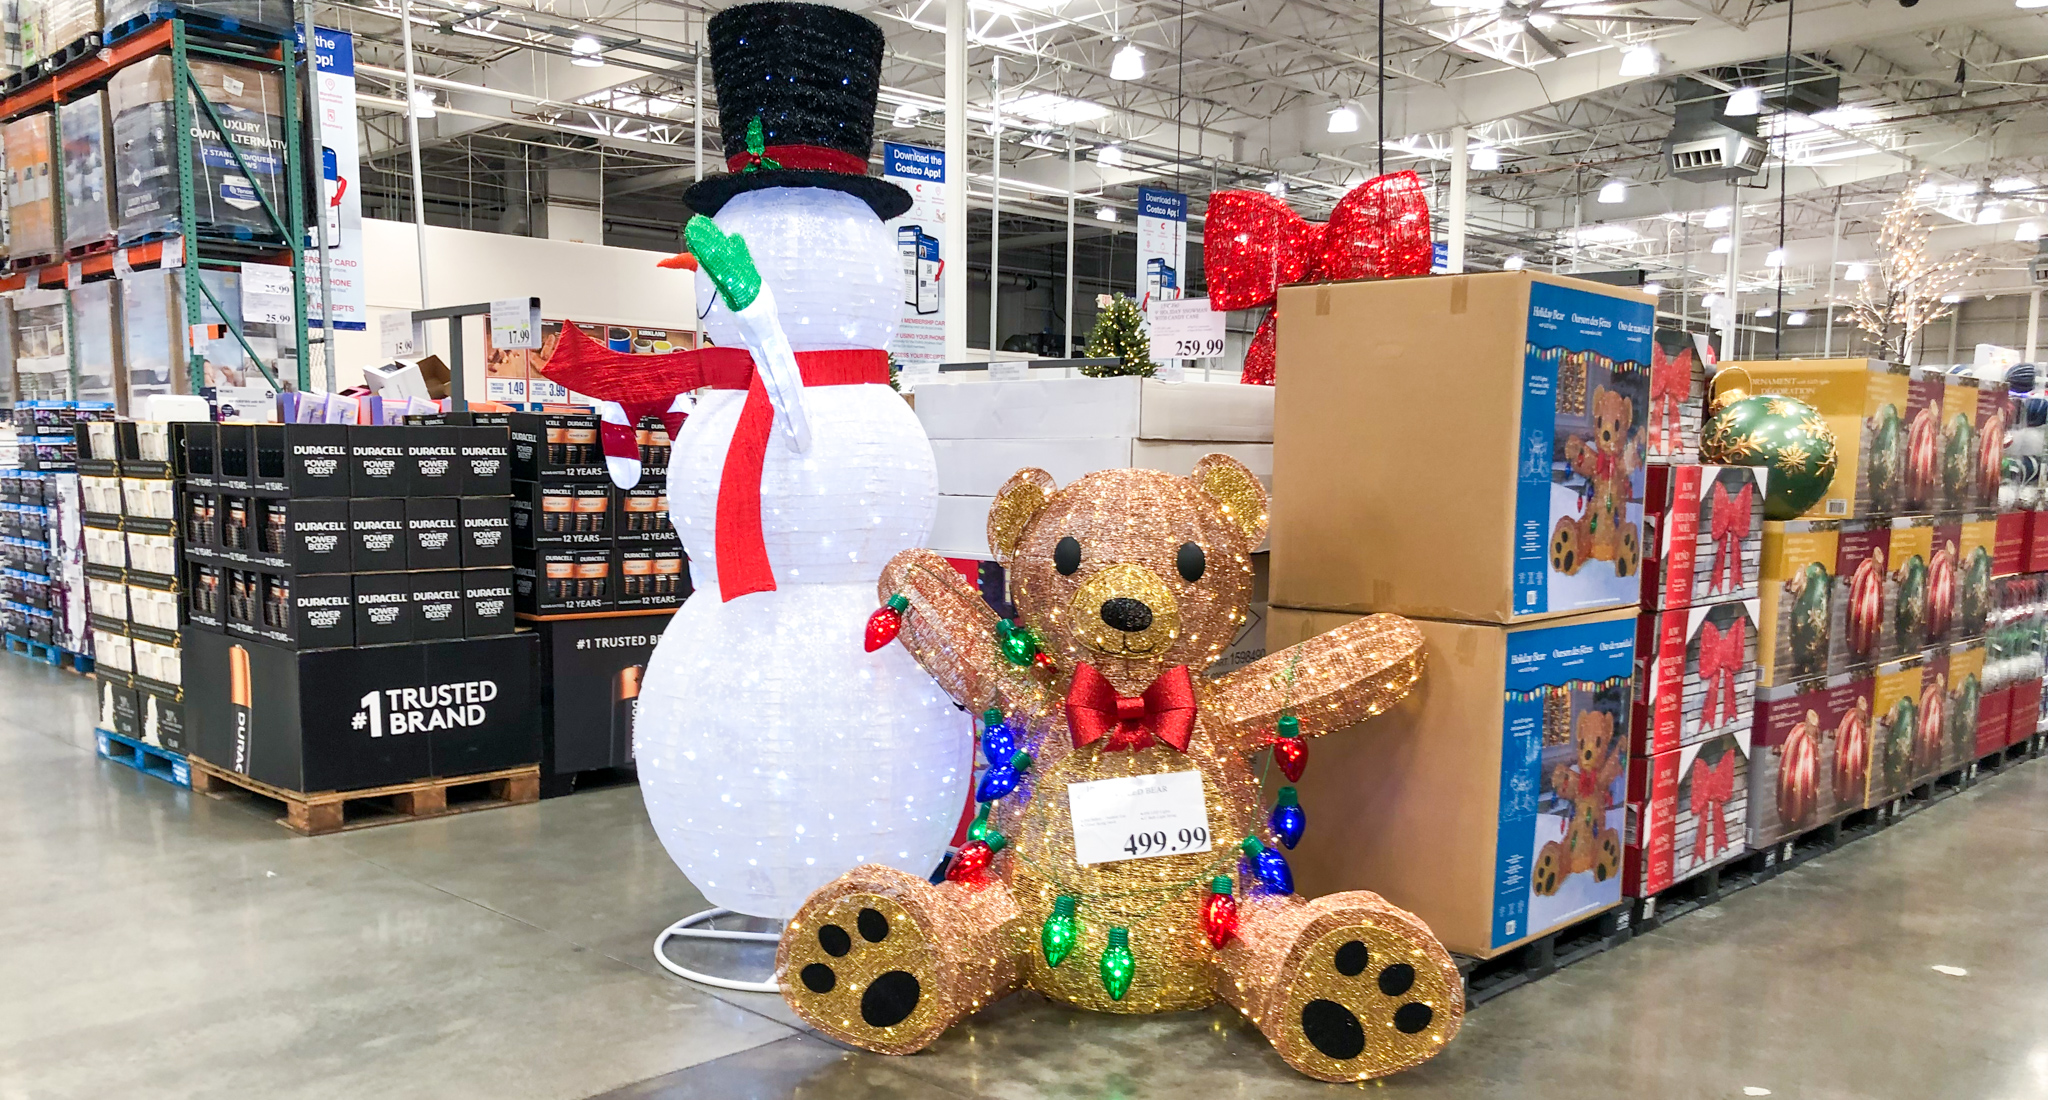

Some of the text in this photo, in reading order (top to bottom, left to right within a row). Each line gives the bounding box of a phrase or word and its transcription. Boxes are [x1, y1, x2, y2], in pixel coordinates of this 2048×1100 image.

[315, 35, 335, 50] the
[222, 119, 260, 133] UXURY
[190, 127, 287, 150] OWN LTERNATIV
[894, 149, 942, 166] Download the
[895, 162, 941, 179] Costco App!
[1145, 193, 1171, 205] Download
[1146, 205, 1166, 215] Costco
[335, 260, 357, 268] CARD
[265, 284, 290, 294] 25.99
[265, 313, 291, 323] 25.99
[1533, 306, 1565, 322] Holiday Bear
[508, 329, 530, 345] 17.99
[638, 330, 666, 338] KIRKLAND
[395, 340, 413, 355] 15.99
[1175, 339, 1224, 356] 259.99
[508, 381, 524, 395] 1.49
[549, 383, 566, 397] 3.99
[512, 432, 537, 443] DURACELL
[294, 446, 346, 455] DURACELL
[353, 447, 403, 456] DURACELL
[409, 447, 456, 456] DURACELL
[462, 447, 507, 456] DURACELL
[304, 460, 337, 468] POWER
[363, 460, 395, 468] POWER
[418, 460, 448, 468] POWER
[471, 460, 500, 468] POWER
[307, 467, 335, 475] BOOST
[366, 467, 393, 475] BOOST
[421, 467, 447, 475] BOOST
[576, 468, 602, 476] YEARS
[295, 521, 346, 531] DURACELL
[353, 521, 402, 530] DURACELL
[409, 519, 456, 529] DURACELL
[464, 518, 509, 528] DURACELL
[305, 535, 337, 544] POWER
[363, 534, 394, 542] POWER
[419, 532, 448, 541] POWER
[473, 531, 501, 539] POWER
[573, 534, 599, 542] YEARS
[650, 532, 674, 540] YEARS
[366, 541, 393, 549] BOOST
[421, 539, 447, 547] BOOST
[476, 537, 500, 545] BOOST
[413, 590, 460, 601] DURACELL
[467, 588, 511, 598] DURACELL
[297, 597, 349, 607] DURACELL
[358, 594, 407, 604] DURACELL
[651, 596, 676, 604] YEARS
[422, 604, 452, 612] POWER
[475, 601, 504, 609] POWER
[575, 600, 602, 608] YEARS
[308, 610, 340, 619] POWER
[368, 607, 399, 615] POWER
[478, 608, 503, 616] BOOST
[311, 617, 339, 626] BOOST
[371, 614, 398, 622] BOOST
[576, 639, 591, 649] #1
[595, 636, 647, 648] TRUSTED
[351, 680, 498, 738] #1 TRUSTED
[389, 704, 486, 735] BRAND
[1146, 785, 1168, 794] BEAR
[1124, 826, 1207, 855] 499.99
